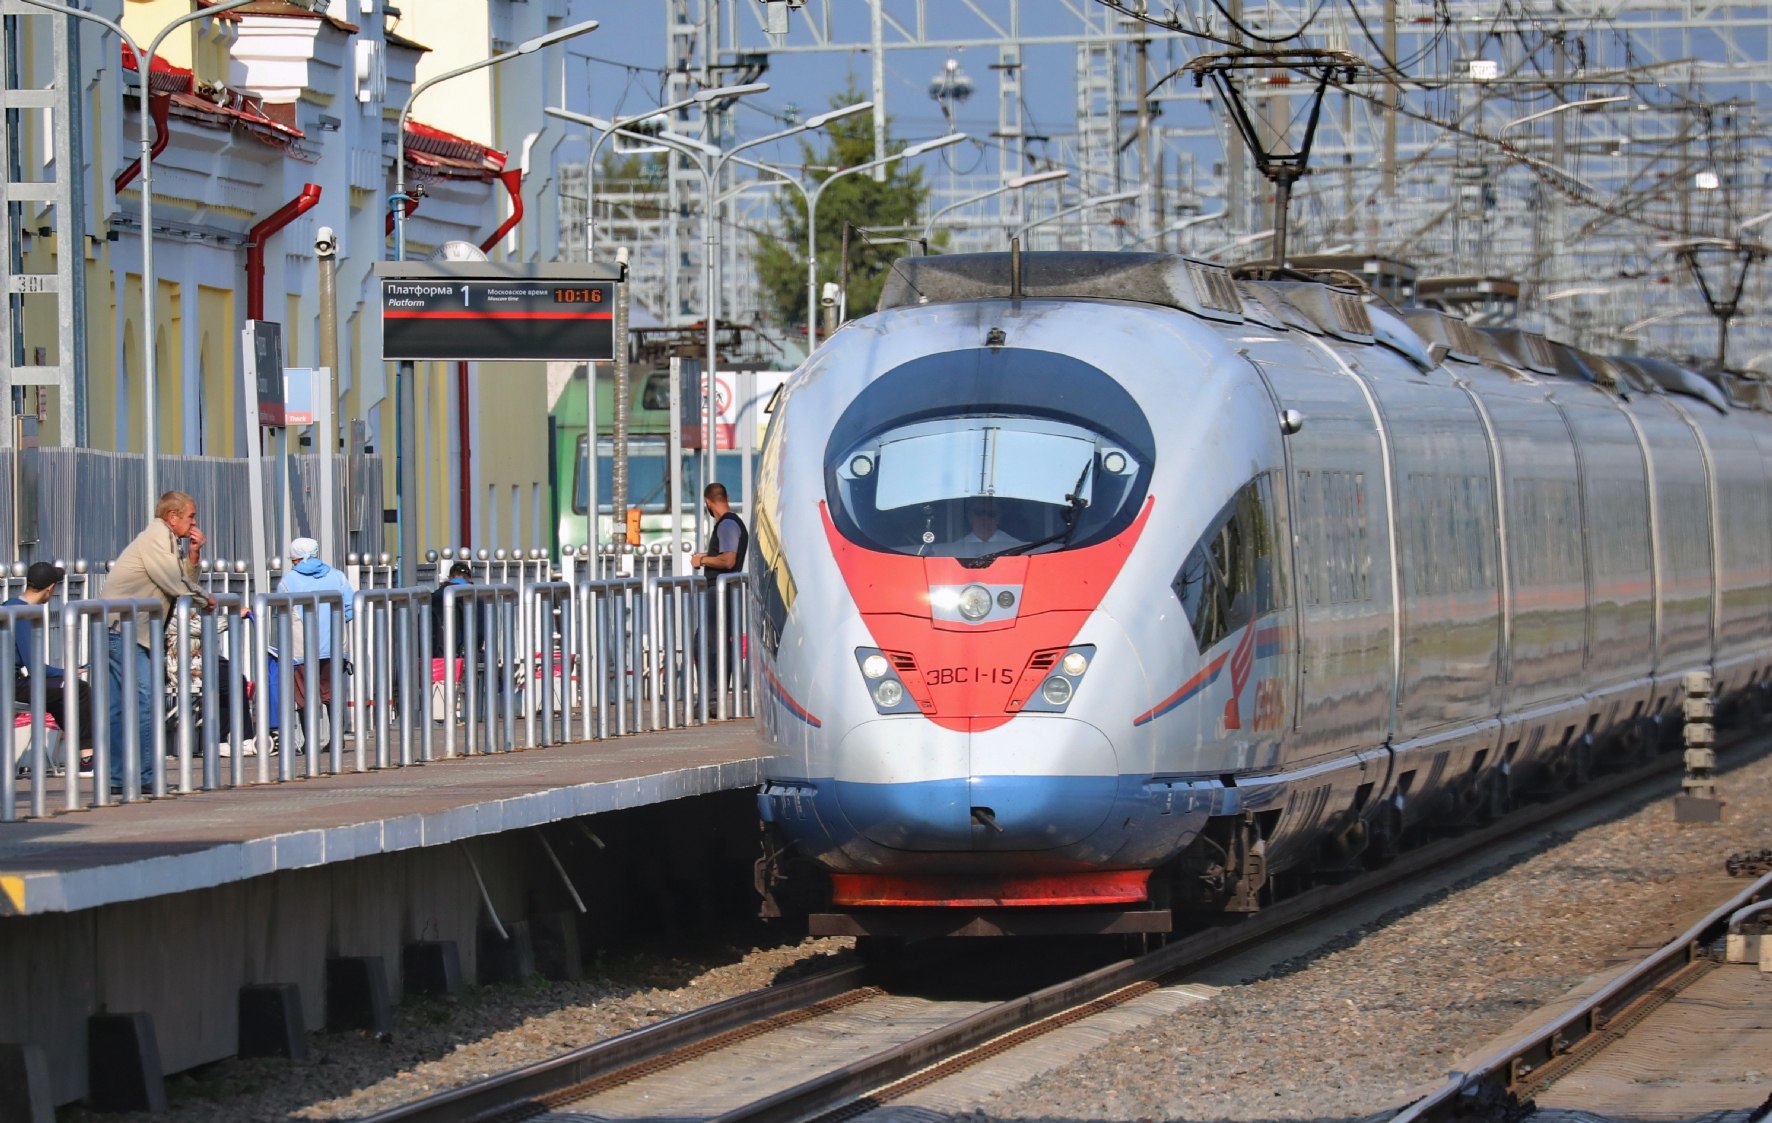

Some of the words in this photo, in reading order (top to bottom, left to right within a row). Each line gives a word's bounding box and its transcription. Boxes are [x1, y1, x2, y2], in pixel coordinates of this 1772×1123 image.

[18, 276, 43, 291] 301
[388, 284, 453, 297] Платформа
[460, 285, 469, 307] 1
[487, 288, 527, 296] Московское
[554, 289, 601, 302] 10:16
[388, 298, 425, 307] Platform
